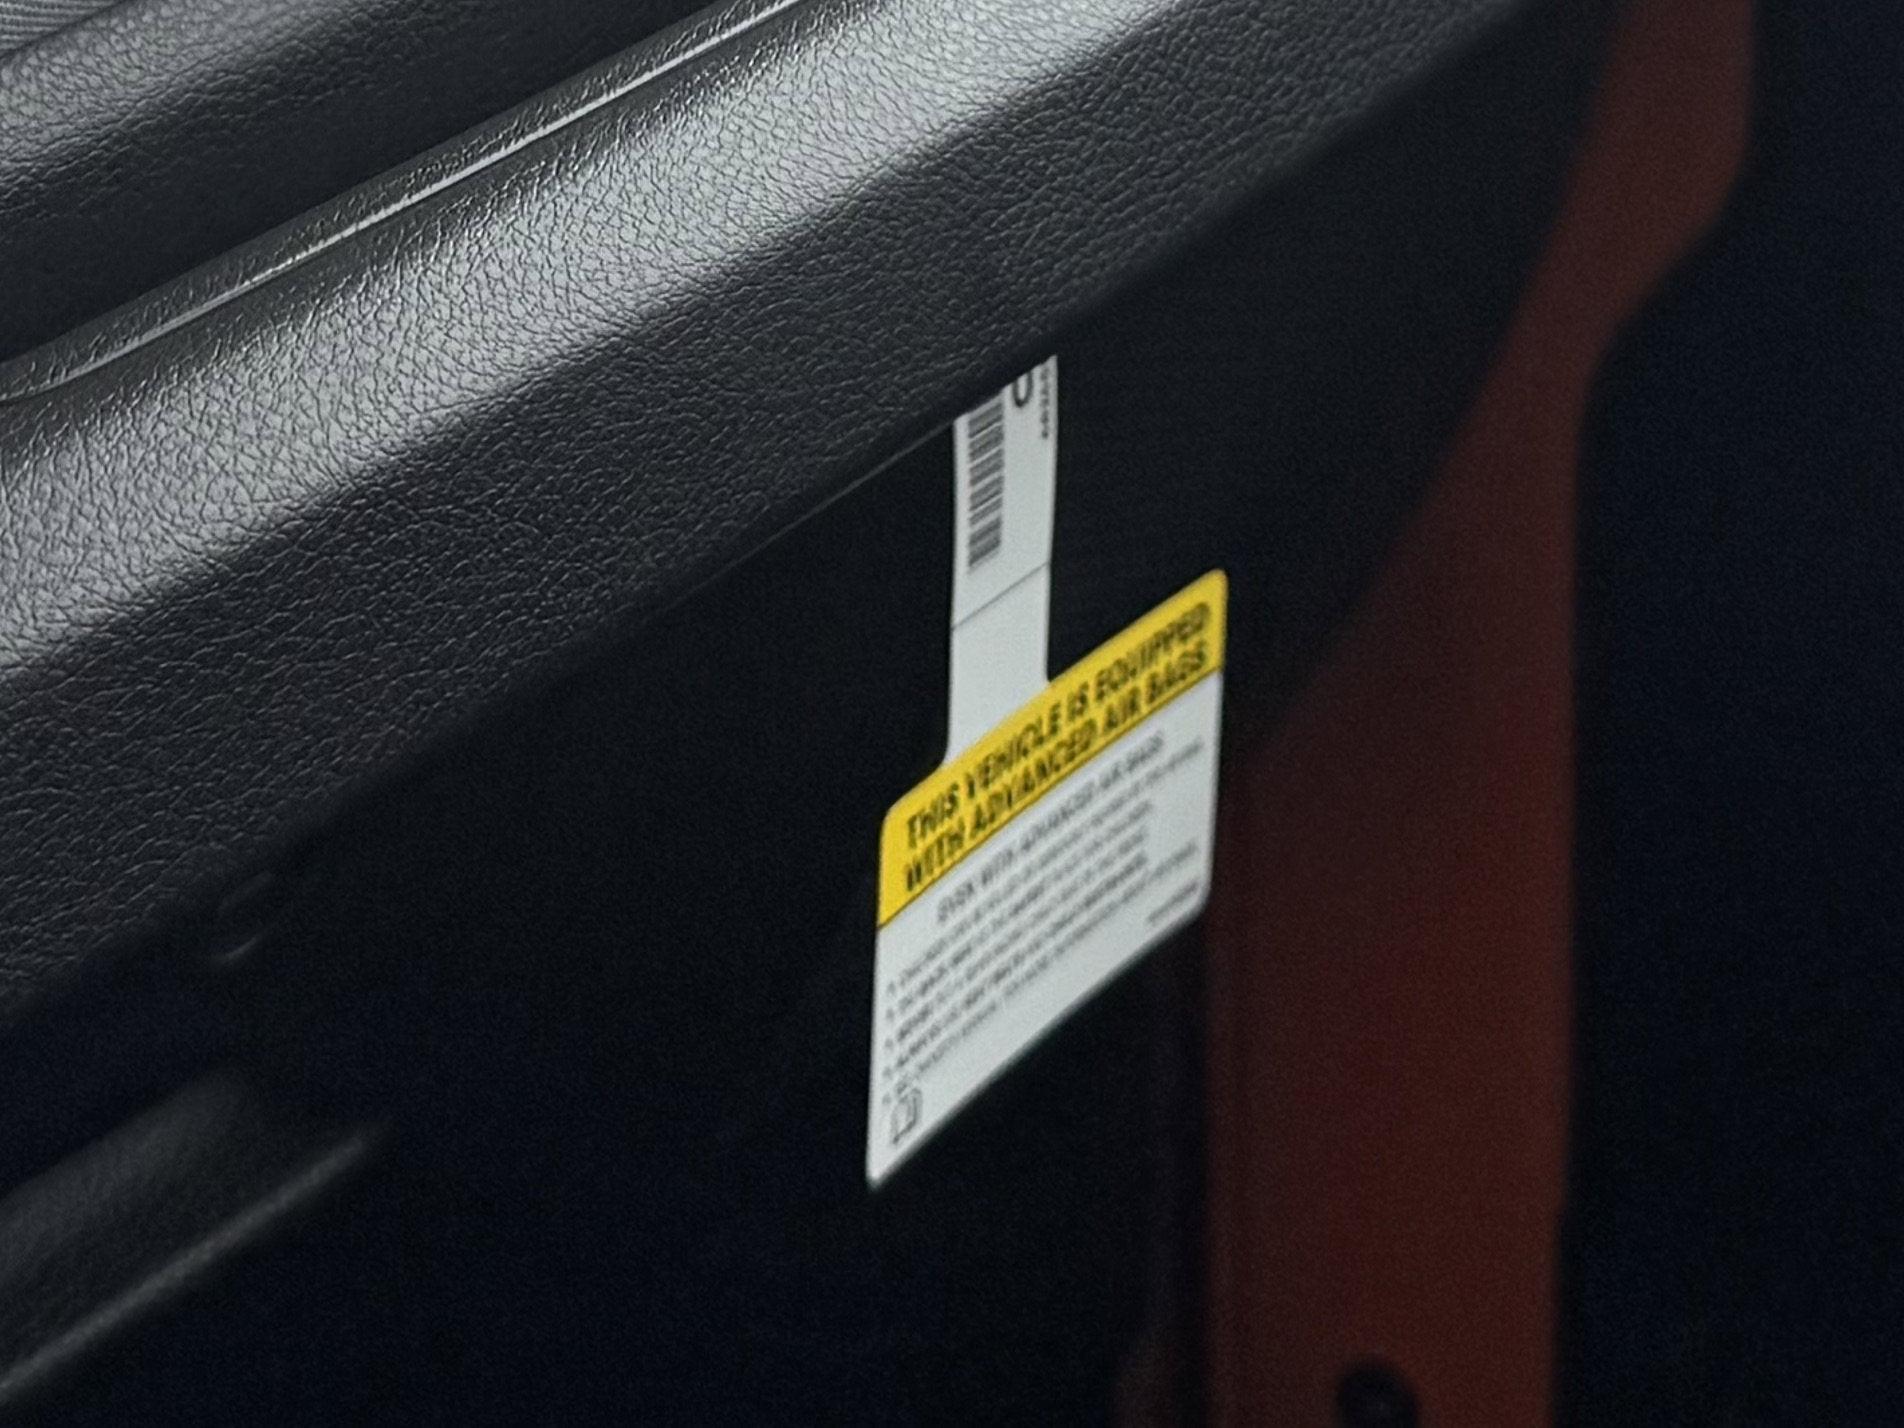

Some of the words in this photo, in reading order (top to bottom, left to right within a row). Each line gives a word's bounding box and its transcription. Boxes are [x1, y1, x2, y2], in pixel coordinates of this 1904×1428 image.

[904, 822, 968, 892] WITH
[969, 719, 1097, 845] ADVANCED
[1099, 689, 1143, 749] AIR
[1144, 639, 1208, 711] BAGS
[906, 785, 961, 846] THIS
[965, 704, 1062, 806] VEHICLE
[1093, 602, 1211, 711] EQUIPPED
